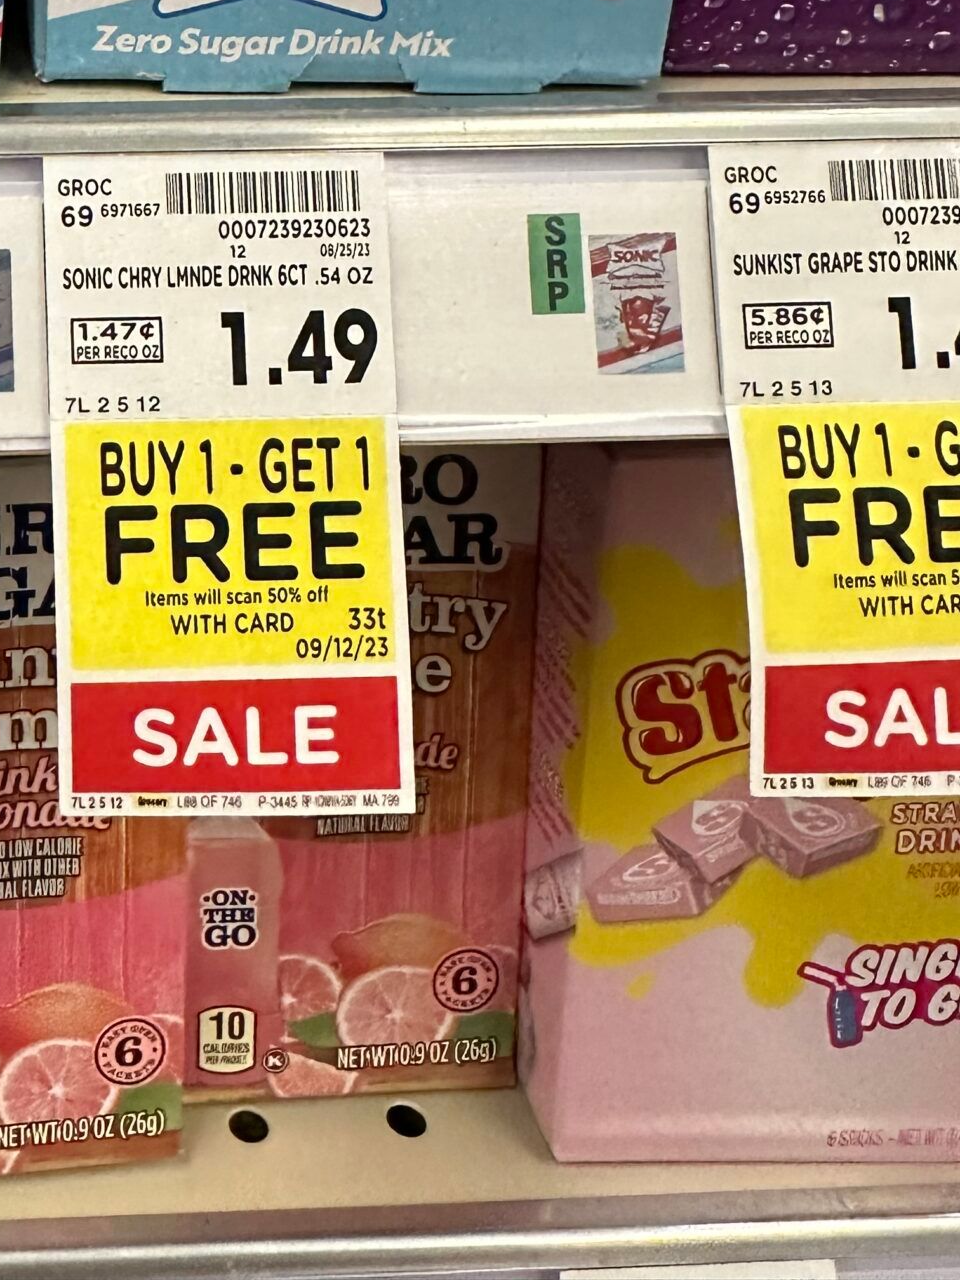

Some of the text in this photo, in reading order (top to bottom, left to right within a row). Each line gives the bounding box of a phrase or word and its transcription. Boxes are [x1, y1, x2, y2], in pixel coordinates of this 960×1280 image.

[92, 25, 454, 63] Zero Sugar Drink Mix
[724, 166, 778, 183] GROC
[58, 179, 112, 196] GROC
[729, 190, 826, 214] 69 6952766
[61, 203, 160, 227] 69 6971667
[219, 218, 371, 239] 0007239230623
[230, 243, 370, 258] 12 08/25/23
[733, 249, 958, 276] SUNKIST GRAPE STO DRINK
[545, 216, 569, 311] SRP
[63, 264, 373, 289] SONIC CHRY LMNDE DRNK 6CT .54 OZ
[751, 307, 825, 326] 5.86¢
[77, 322, 154, 341] 1.47¢
[221, 308, 378, 386] 1.49
[100, 440, 185, 497] BUY
[199, 438, 213, 495] 1
[259, 437, 340, 493] GET
[355, 436, 369, 491] 1
[104, 501, 365, 585] FREE
[145, 585, 329, 607] Items will scan 50% off
[170, 612, 294, 636] WITH CARD
[348, 607, 387, 631] 33t
[296, 636, 388, 661] 09/12/23
[132, 704, 340, 767] SALE
[29, 1122, 58, 1145] WT
[93, 1115, 116, 1139] OZ
[119, 1109, 165, 1139] (26g)
